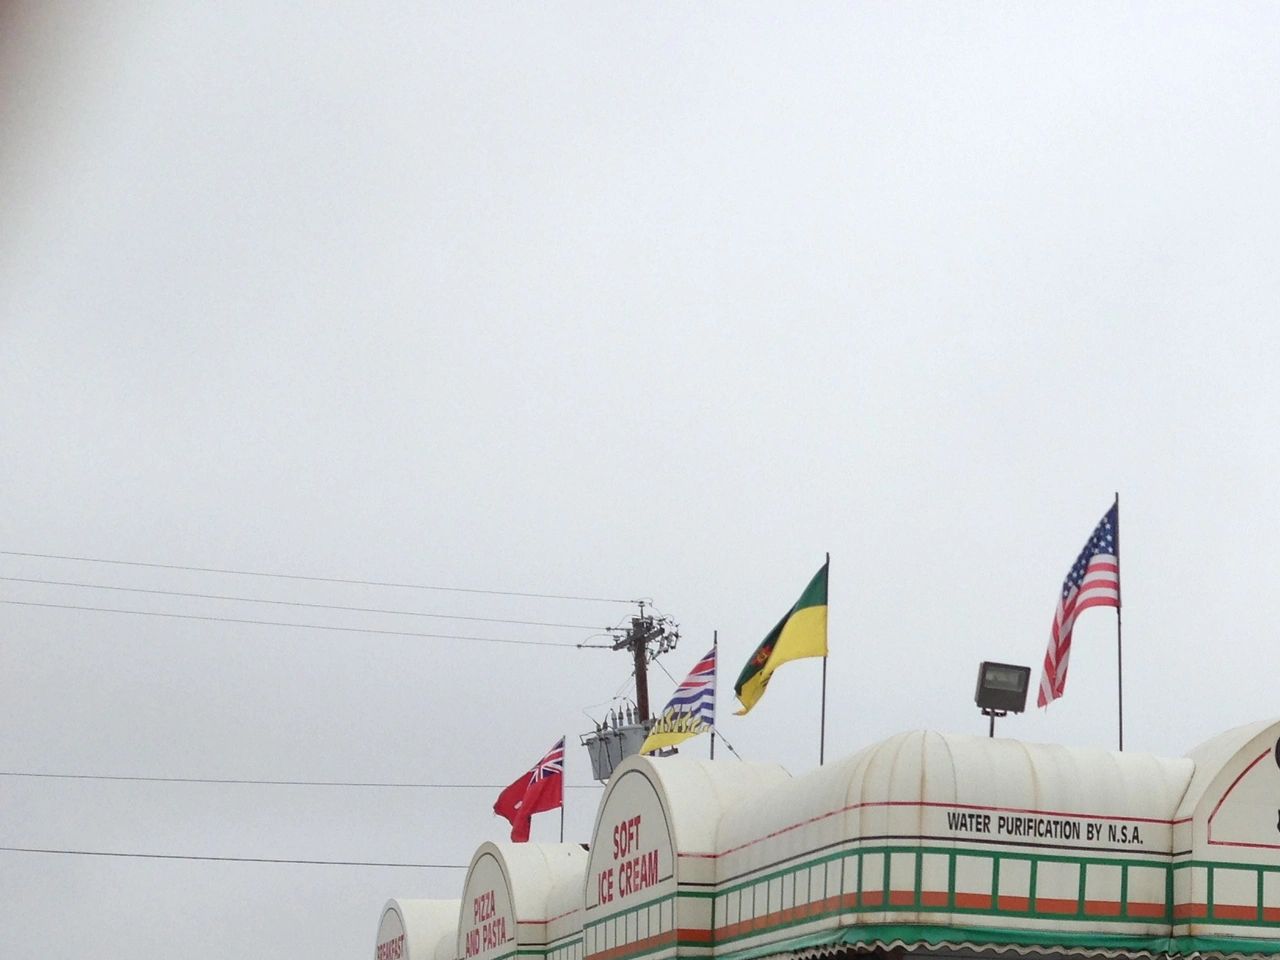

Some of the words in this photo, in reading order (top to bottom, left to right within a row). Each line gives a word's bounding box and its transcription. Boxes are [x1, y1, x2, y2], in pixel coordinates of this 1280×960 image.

[613, 815, 641, 860] SOFT
[947, 812, 990, 833] WATER
[998, 816, 1081, 840] PURIFICATION
[1087, 823, 1102, 841] BY
[1108, 824, 1144, 845] N.S.A.
[598, 868, 613, 906] ICE
[619, 849, 658, 898] CREAM
[474, 890, 496, 925] PIZZA
[465, 929, 480, 959] AND
[483, 917, 507, 952] PASTA
